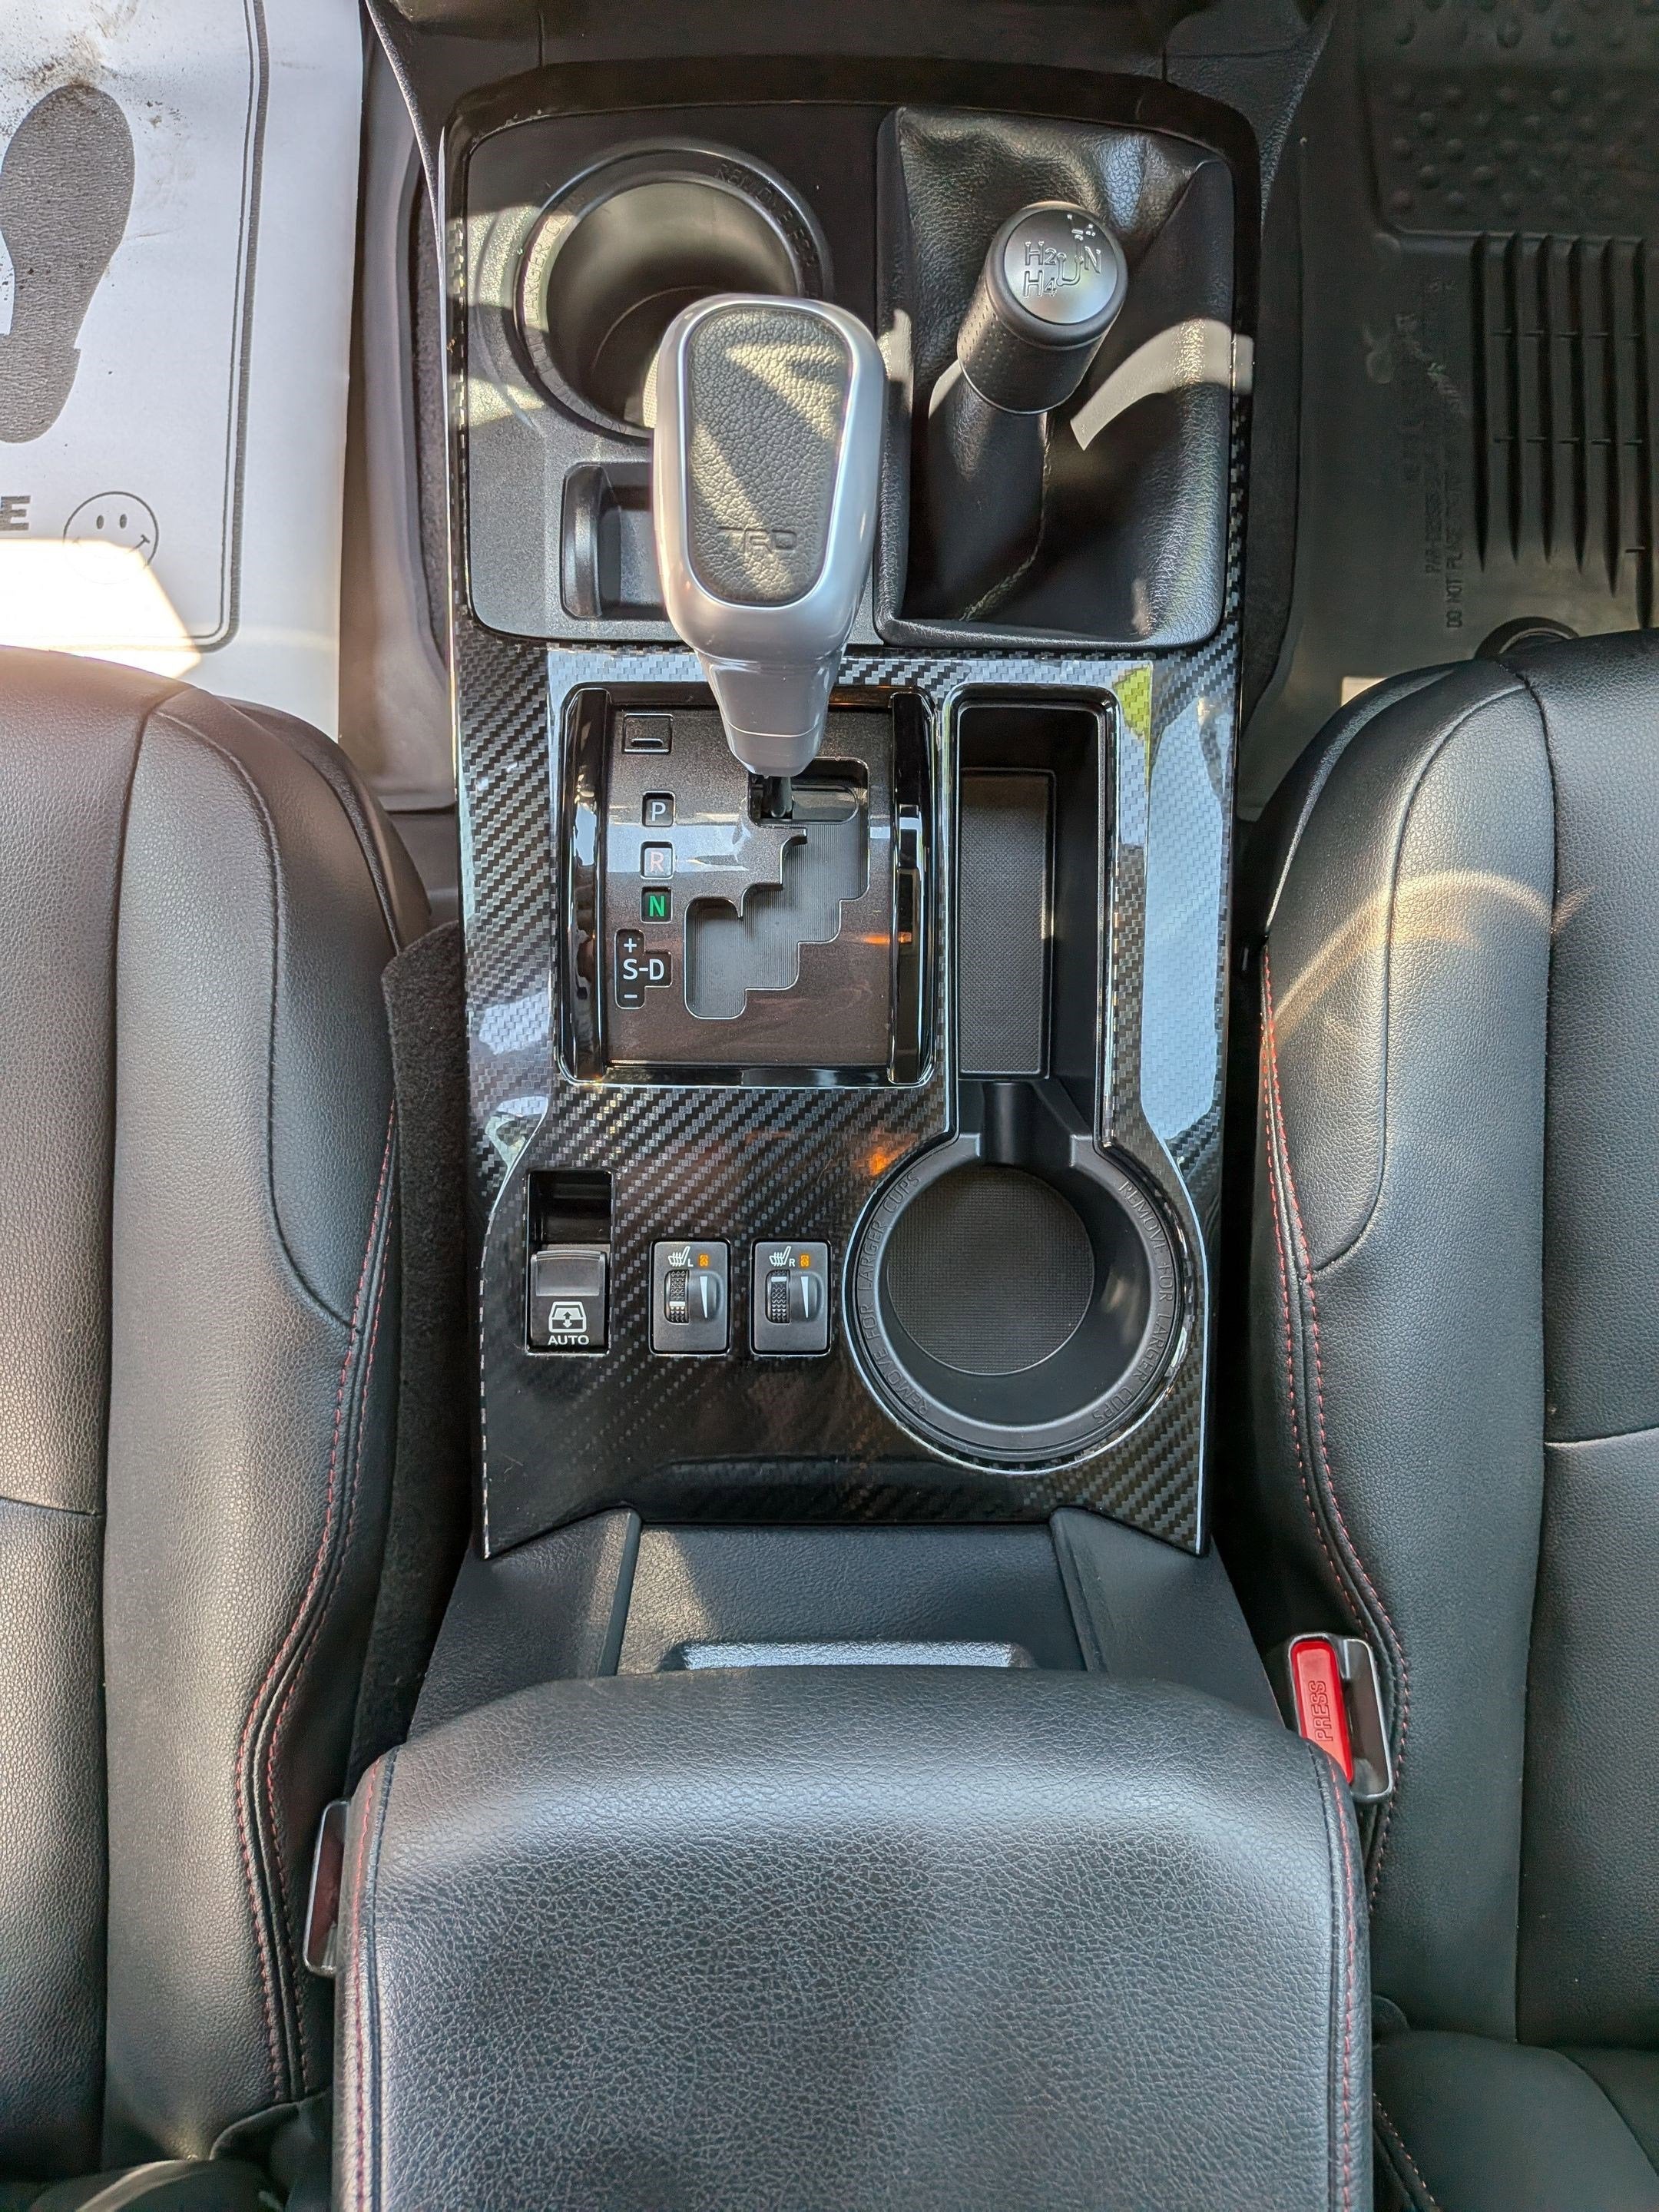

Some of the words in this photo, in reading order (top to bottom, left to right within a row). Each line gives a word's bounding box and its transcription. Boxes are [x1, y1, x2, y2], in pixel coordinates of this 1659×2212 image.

[1025, 240, 1057, 266] H2
[1084, 246, 1101, 274] N
[522, 243, 550, 323] LARGER
[1023, 270, 1057, 298] H4
[717, 525, 797, 559] TRD
[651, 801, 667, 822] P
[649, 851, 664, 873] R
[649, 896, 665, 917] N
[883, 1171, 921, 1214] CUPS
[1118, 1180, 1167, 1255] REMOVE
[687, 1258, 694, 1267] L
[789, 1258, 796, 1267] R
[858, 1220, 886, 1291] LARGER
[1157, 1262, 1173, 1301] FOR
[859, 1303, 882, 1341] FOR
[548, 1334, 590, 1346] AUTO
[1132, 1313, 1172, 1382] LARGER
[874, 1349, 931, 1416] REMOVE
[1092, 1386, 1134, 1423] CUPS
[1308, 1680, 1333, 1741] PRESS
